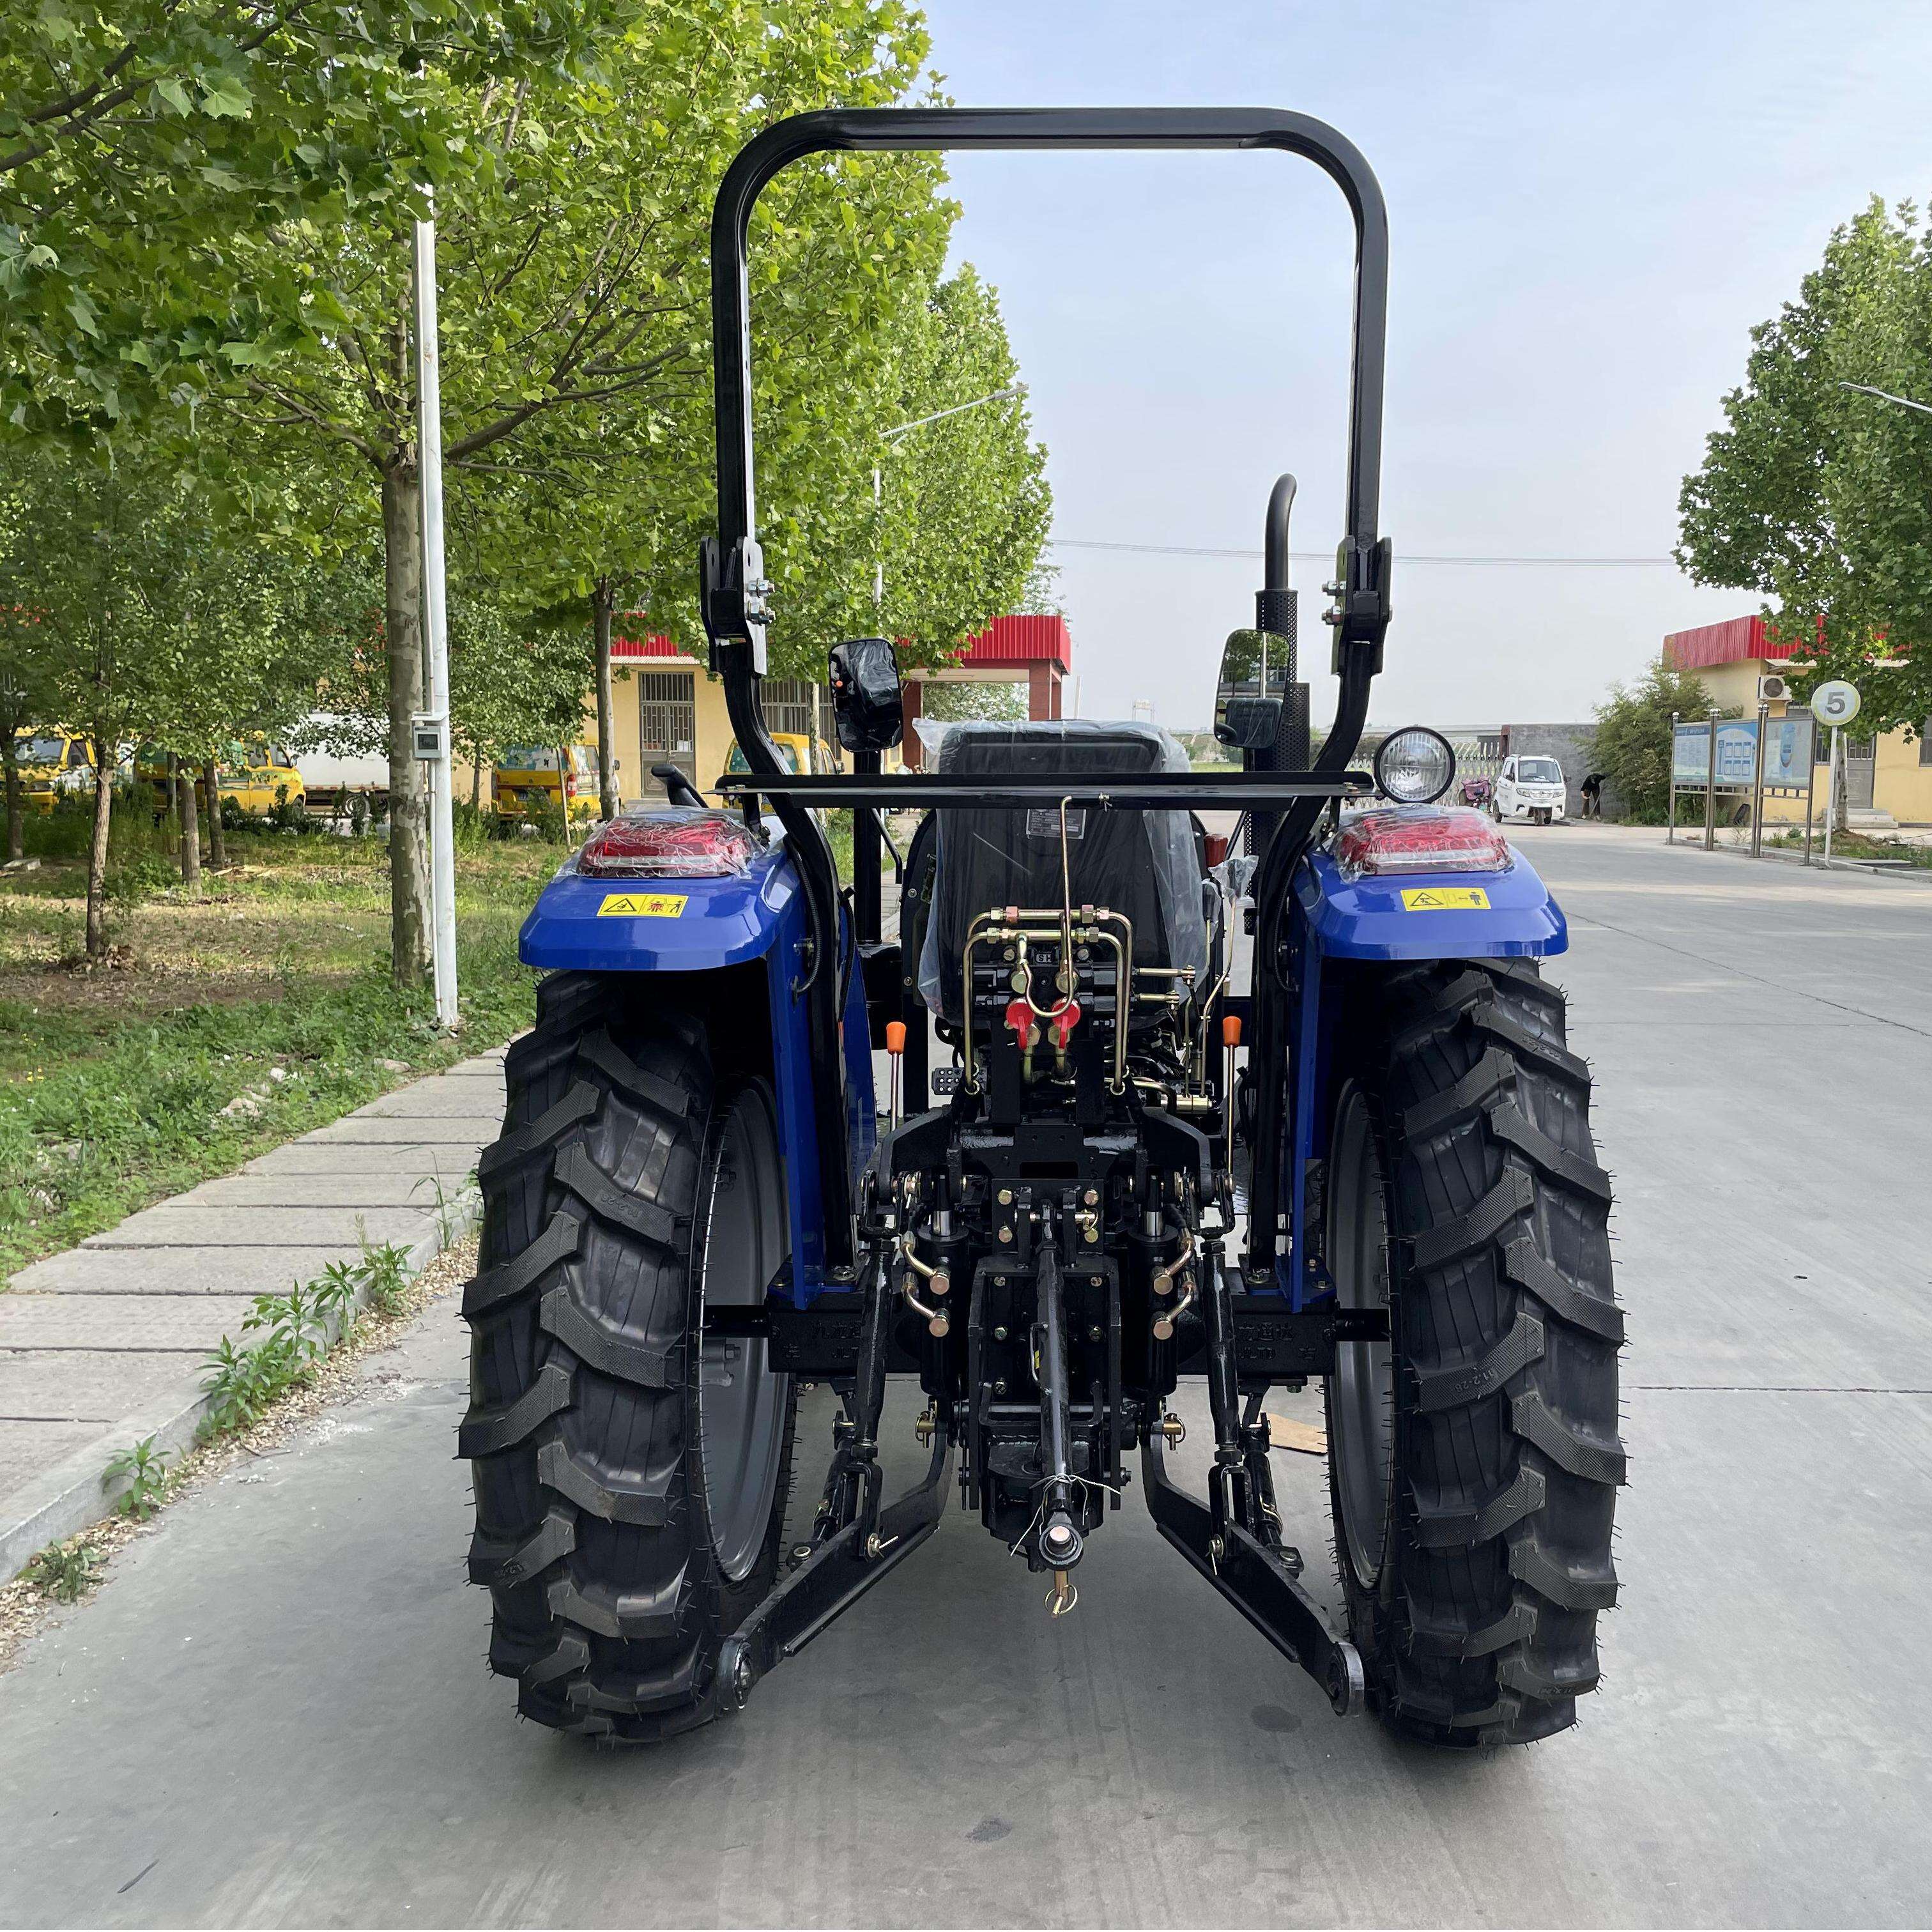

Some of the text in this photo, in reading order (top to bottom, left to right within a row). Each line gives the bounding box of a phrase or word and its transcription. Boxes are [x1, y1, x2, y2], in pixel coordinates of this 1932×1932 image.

[1826, 692, 1845, 714] 5
[831, 1346, 859, 1359] JLT
[1455, 1370, 1495, 1392] 11.2-28
